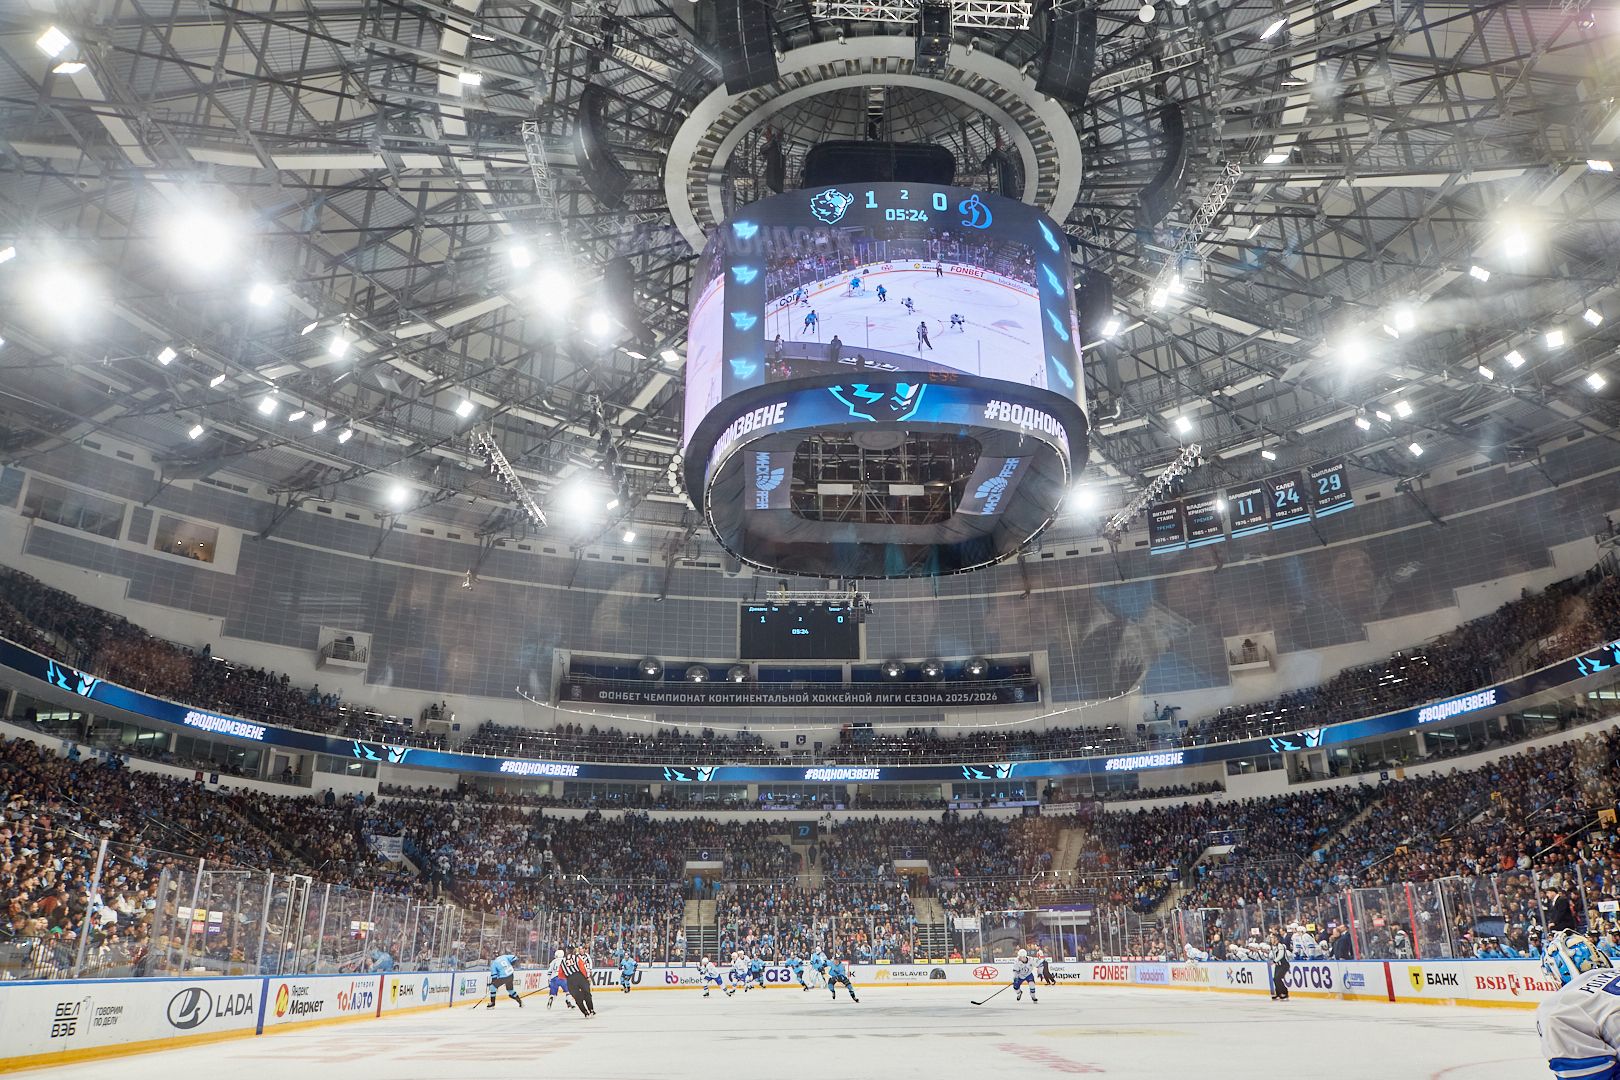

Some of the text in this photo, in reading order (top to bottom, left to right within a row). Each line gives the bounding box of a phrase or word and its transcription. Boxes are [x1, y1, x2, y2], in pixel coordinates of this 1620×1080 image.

[865, 191, 878, 208] 1
[901, 190, 909, 200] 2
[933, 193, 947, 211] 0
[885, 209, 928, 222] 05:24
[951, 266, 984, 278] FONBET
[1317, 474, 1341, 495] 29
[1274, 489, 1300, 508] 24
[1238, 498, 1254, 516] 11
[599, 690, 998, 703] ФОНБЕТ ЧЕМПИОНАТ КОНТИНЕНТАЛЬНОЙ ХОККЕЙНОЙ ЛИГИ СЕЗОНА 2025/2026
[1418, 689, 1496, 723] #ВОДНОМЗВЕНЕ
[183, 710, 266, 741] #ВОДНОМЗВЕНЕ
[500, 760, 579, 777] #ВОДНОМЗВЕНЕ
[1105, 752, 1184, 771] #ВОДНОМЗВЕНЕ
[805, 768, 881, 782] #ВОДНОМЗВЕНЕ
[680, 973, 703, 985] belbet
[1051, 972, 1080, 980] Маркет
[1093, 965, 1128, 981] FONBET
[1236, 968, 1254, 985] сбп
[1426, 973, 1459, 986] БАНК
[467, 979, 478, 988] TEZ
[1475, 975, 1507, 990] BSB
[291, 985, 309, 997] Яндекс
[399, 984, 416, 997] БАНК
[55, 1002, 81, 1016] БЕЛ
[95, 1005, 123, 1016] ГОВОРИМ
[215, 993, 254, 1018] LADA
[288, 999, 324, 1016] Маркет
[93, 1016, 119, 1027] ПО ДЕЛУ
[51, 1022, 77, 1038] ВЭБ
